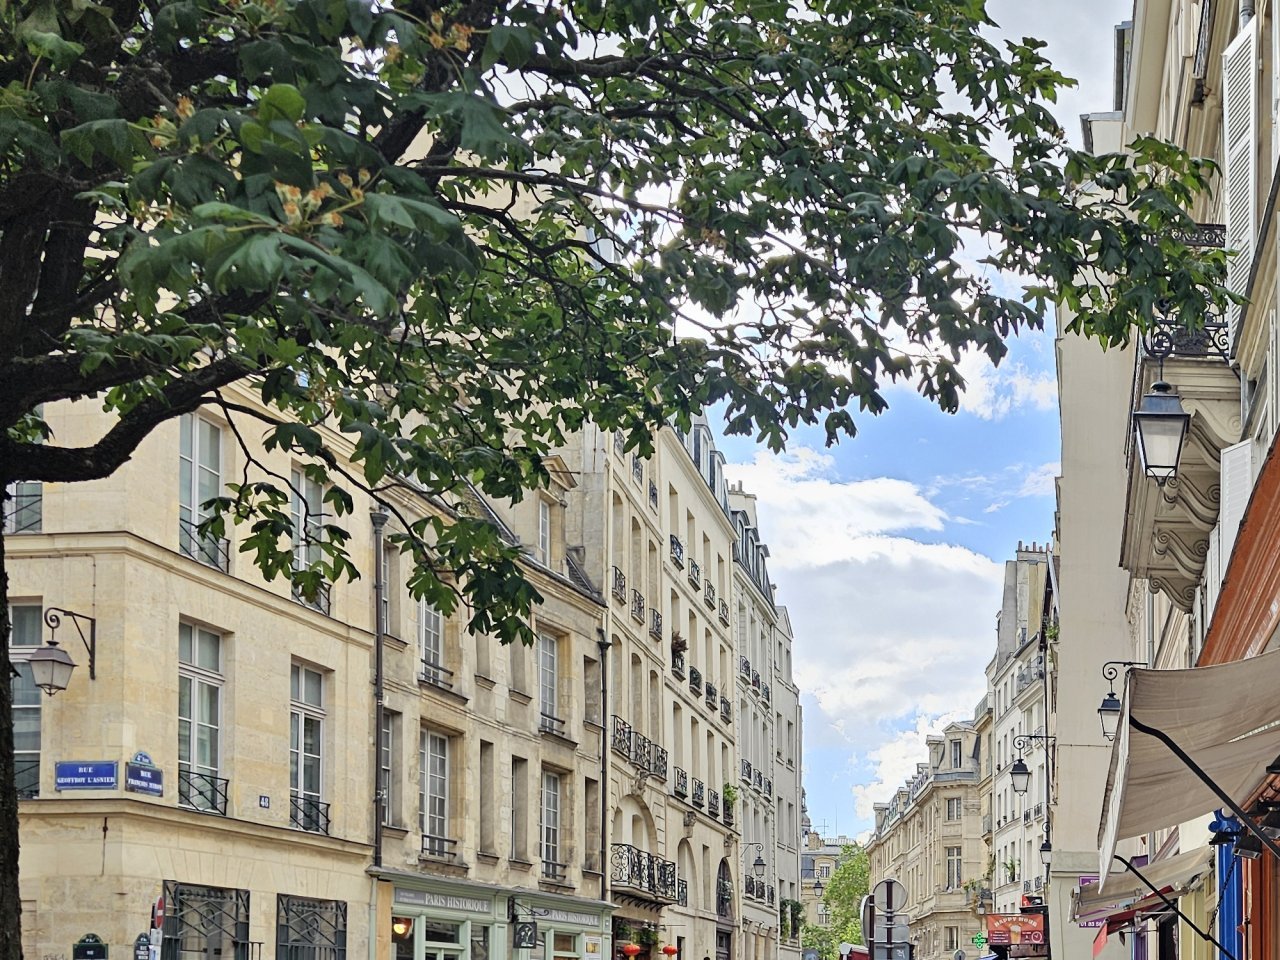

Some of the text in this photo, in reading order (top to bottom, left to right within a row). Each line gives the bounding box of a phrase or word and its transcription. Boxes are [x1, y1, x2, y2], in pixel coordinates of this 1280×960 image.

[425, 893, 446, 907] PARIS
[447, 895, 489, 912] HISTORIQUE
[994, 916, 1038, 928] HAPPY HOUR
